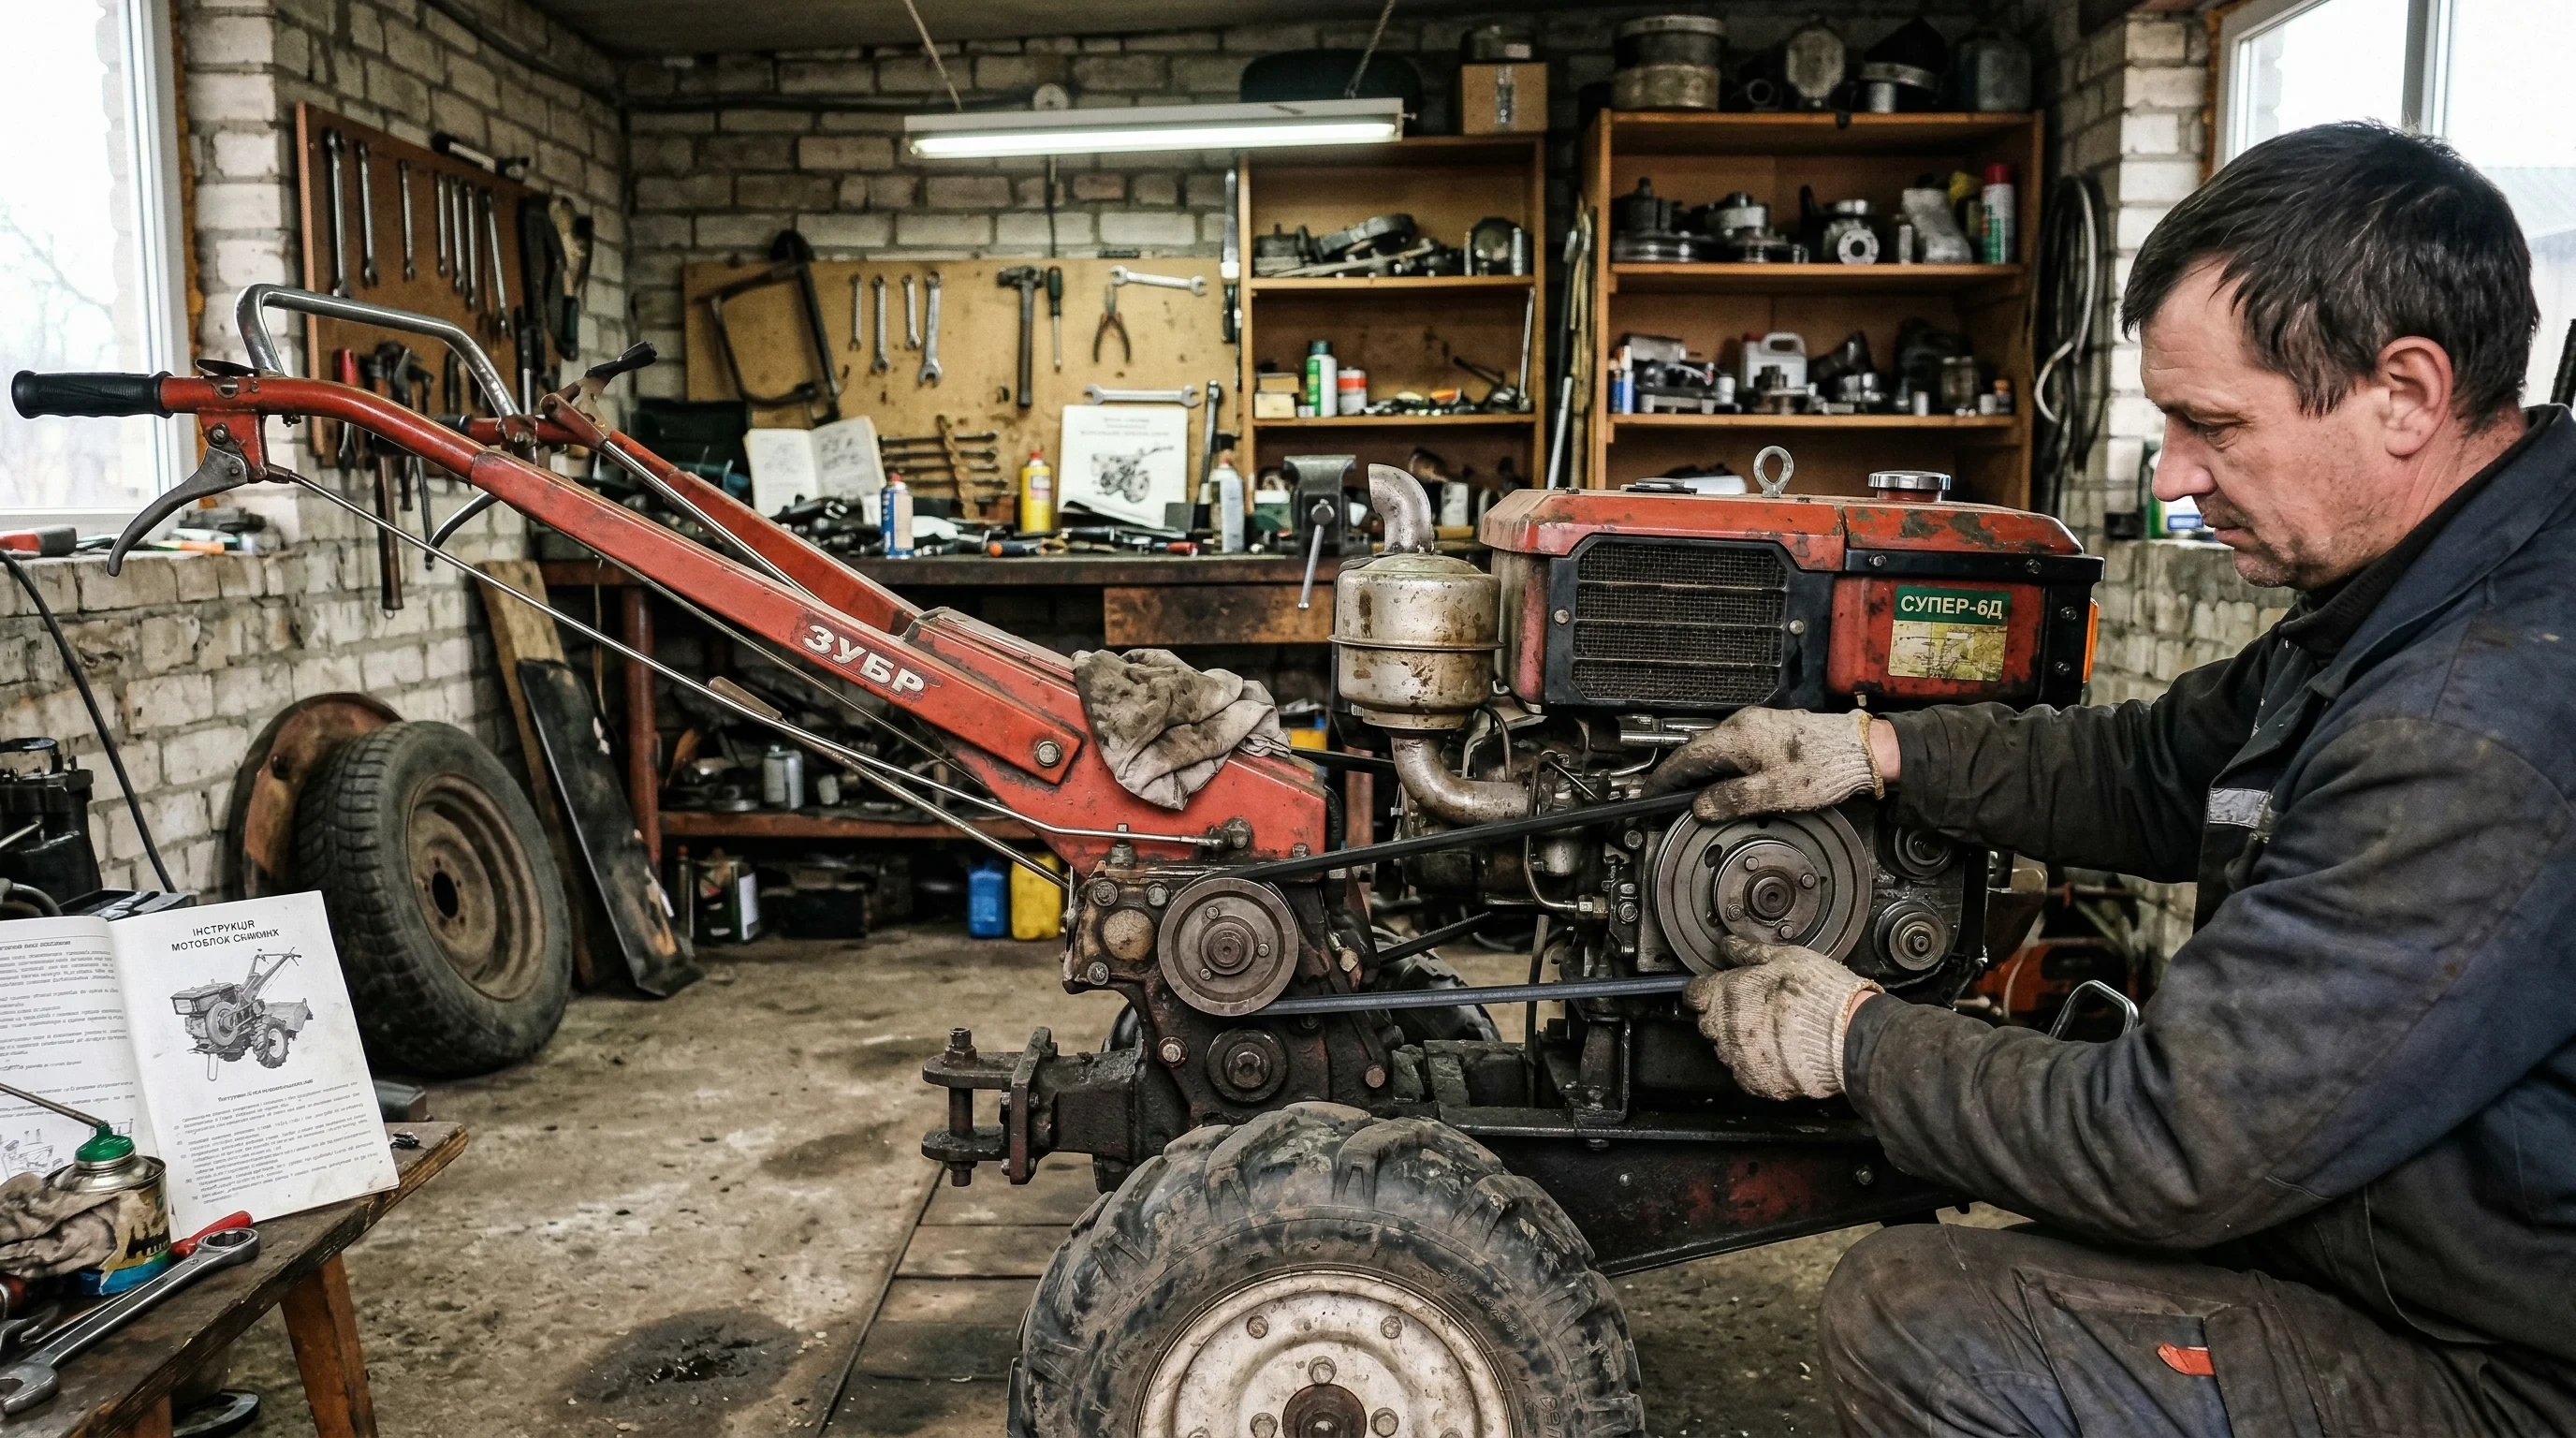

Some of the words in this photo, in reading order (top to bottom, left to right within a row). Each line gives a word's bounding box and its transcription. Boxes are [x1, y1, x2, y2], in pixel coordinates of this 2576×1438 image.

[1900, 594, 2003, 620] СУПЕР-6Д
[801, 624, 925, 694] ЗУБР
[170, 935, 231, 952] МОТОБЛОК
